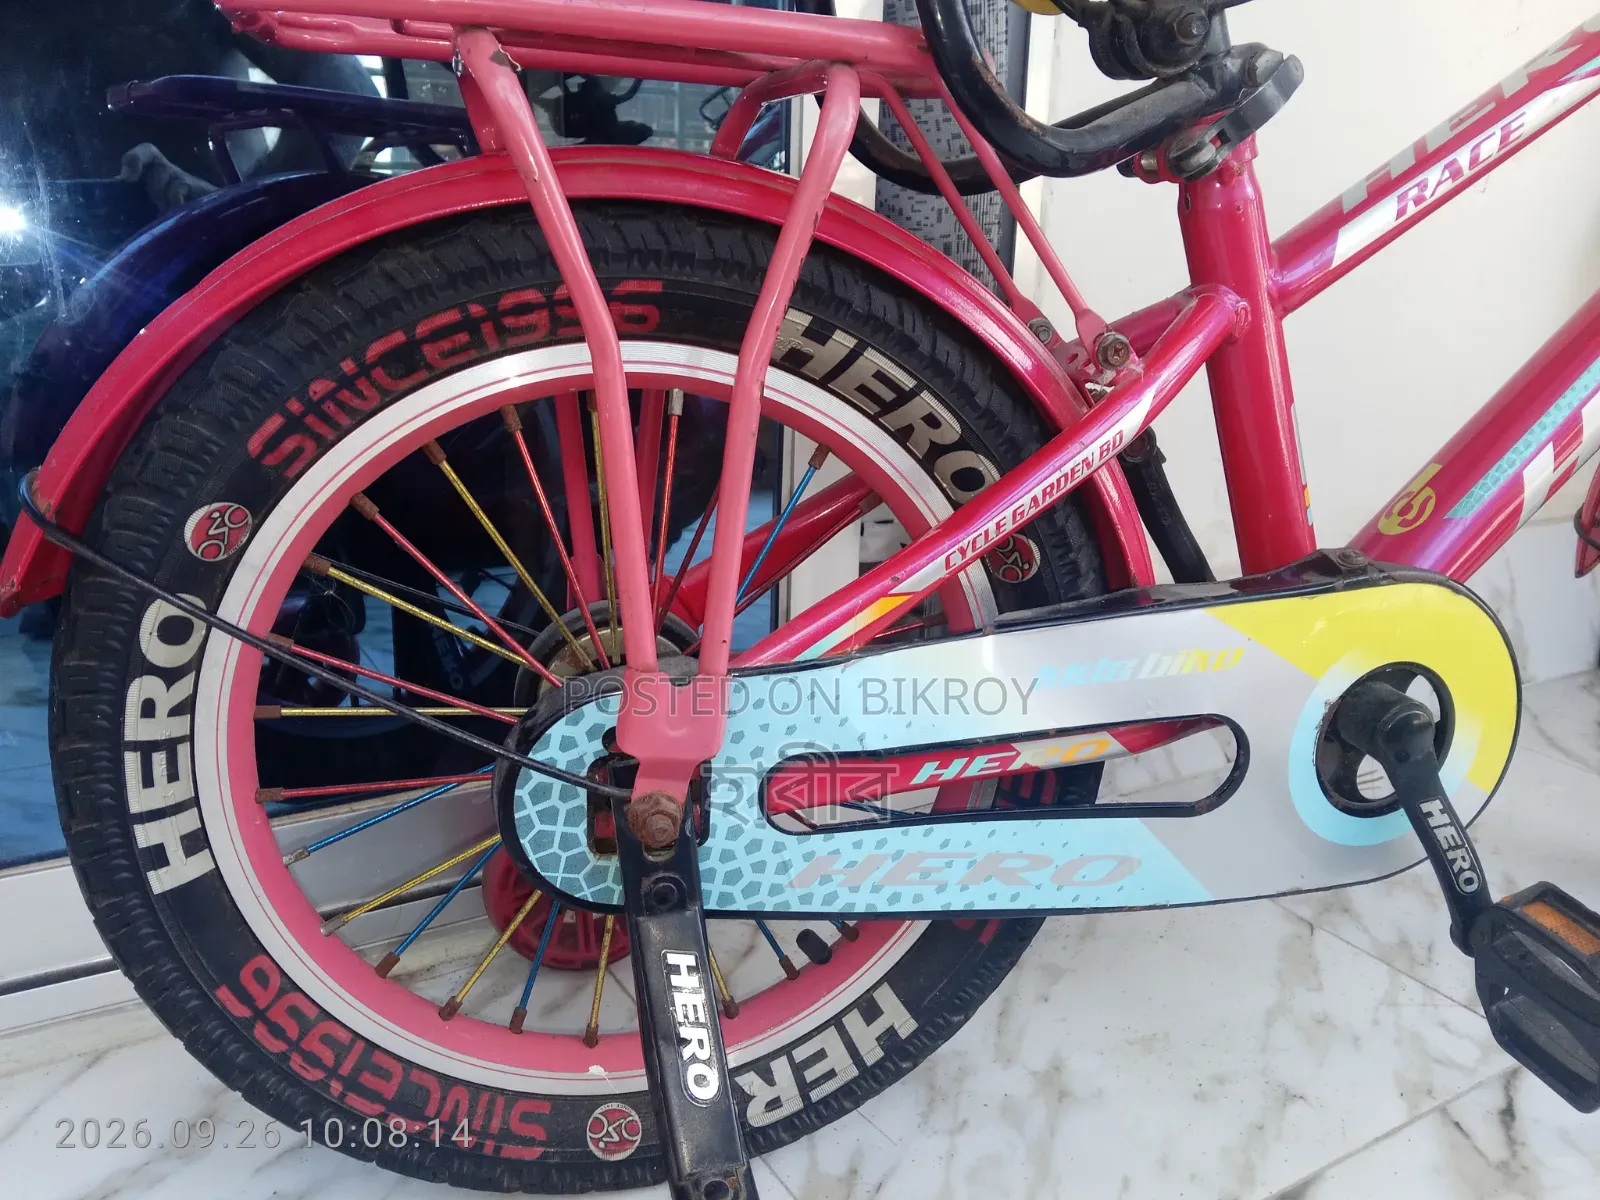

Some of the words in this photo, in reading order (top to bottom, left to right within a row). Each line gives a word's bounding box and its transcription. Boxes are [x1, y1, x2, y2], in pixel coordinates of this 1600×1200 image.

[1394, 111, 1527, 222] RACE
[774, 307, 1001, 505] HERO
[944, 518, 1007, 572] CYCLE
[1011, 452, 1095, 526] GARDEN
[1098, 429, 1124, 462] BD
[124, 593, 216, 895] HERO
[909, 739, 1111, 785] HERO
[784, 852, 1143, 889] HERO
[1420, 799, 1479, 893] HERO
[666, 952, 719, 1100] HERO
[733, 981, 919, 1128] HER
